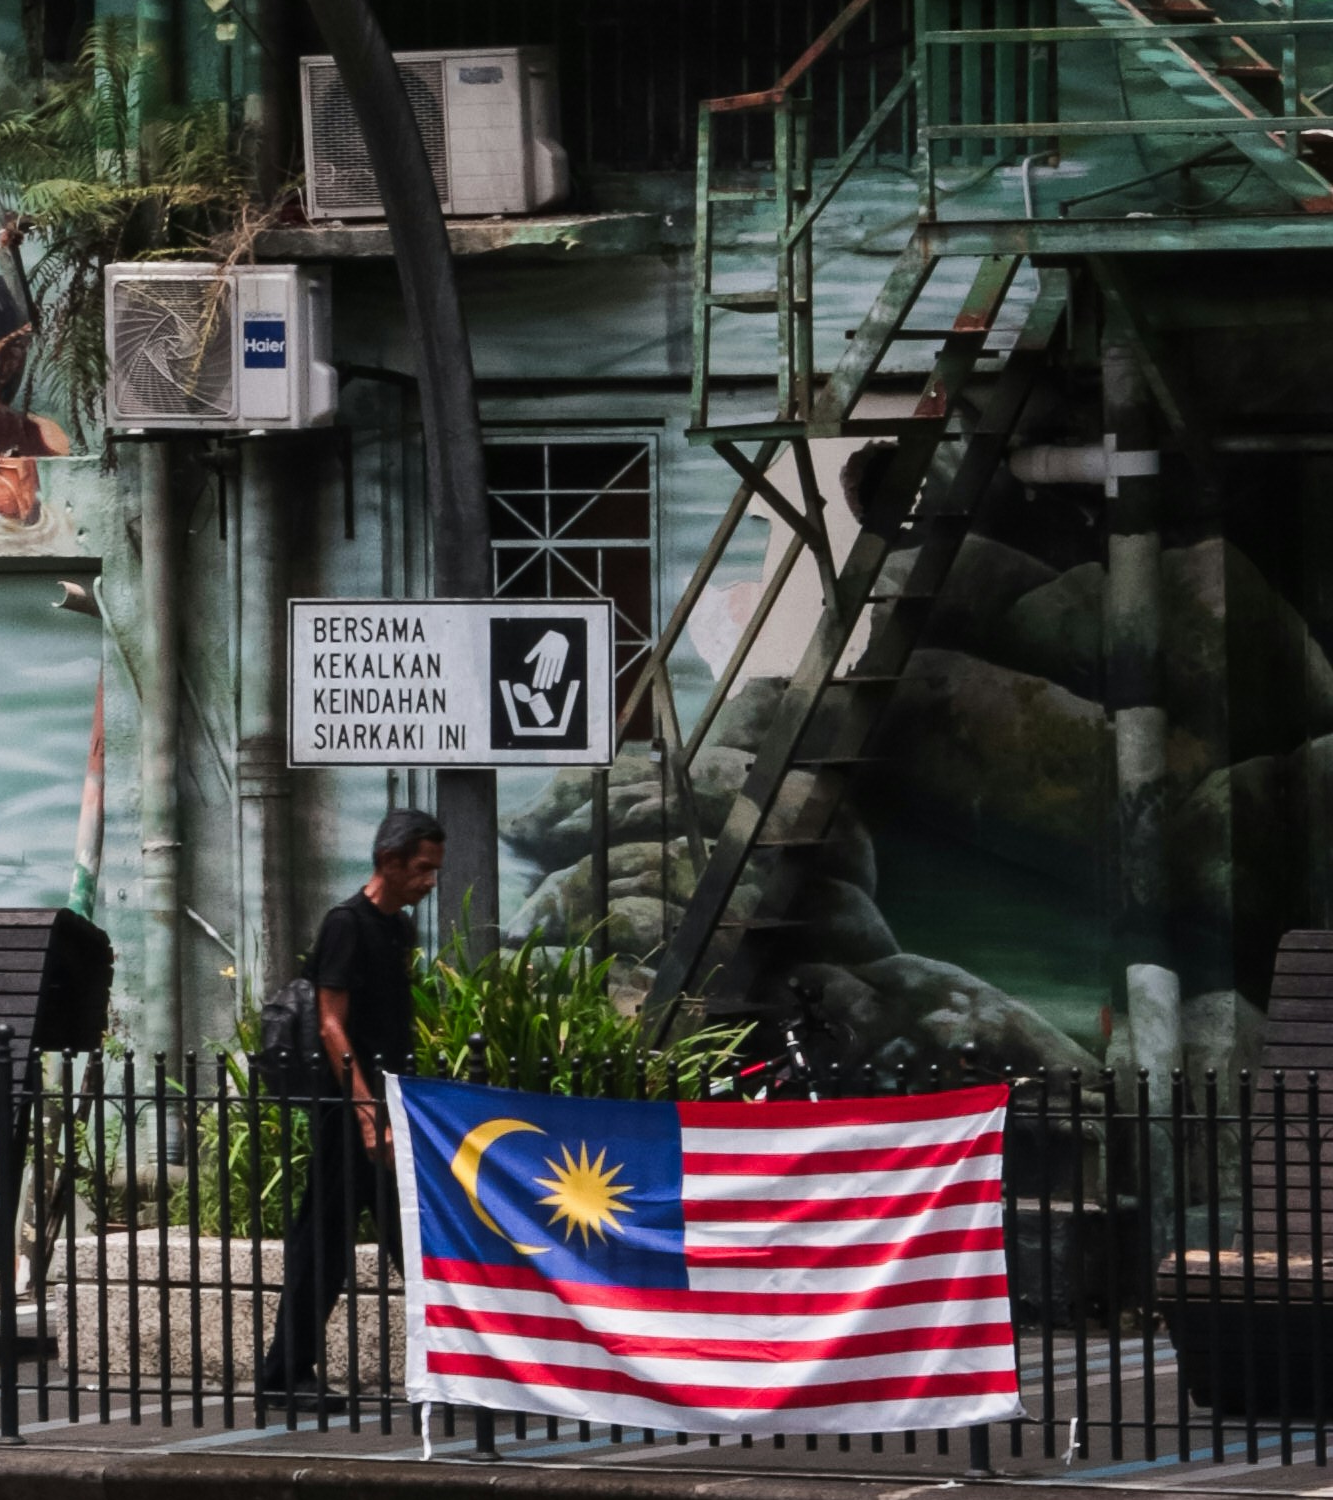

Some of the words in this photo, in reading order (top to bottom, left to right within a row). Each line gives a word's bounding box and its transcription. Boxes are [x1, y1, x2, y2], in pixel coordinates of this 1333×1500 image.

[244, 337, 286, 353] Haier
[314, 618, 424, 642] BERSAMA
[315, 654, 440, 678] KEKALKAN
[315, 689, 445, 714] KEINDAHAN
[315, 724, 423, 749] SIARKAKI
[440, 725, 465, 749] INI
